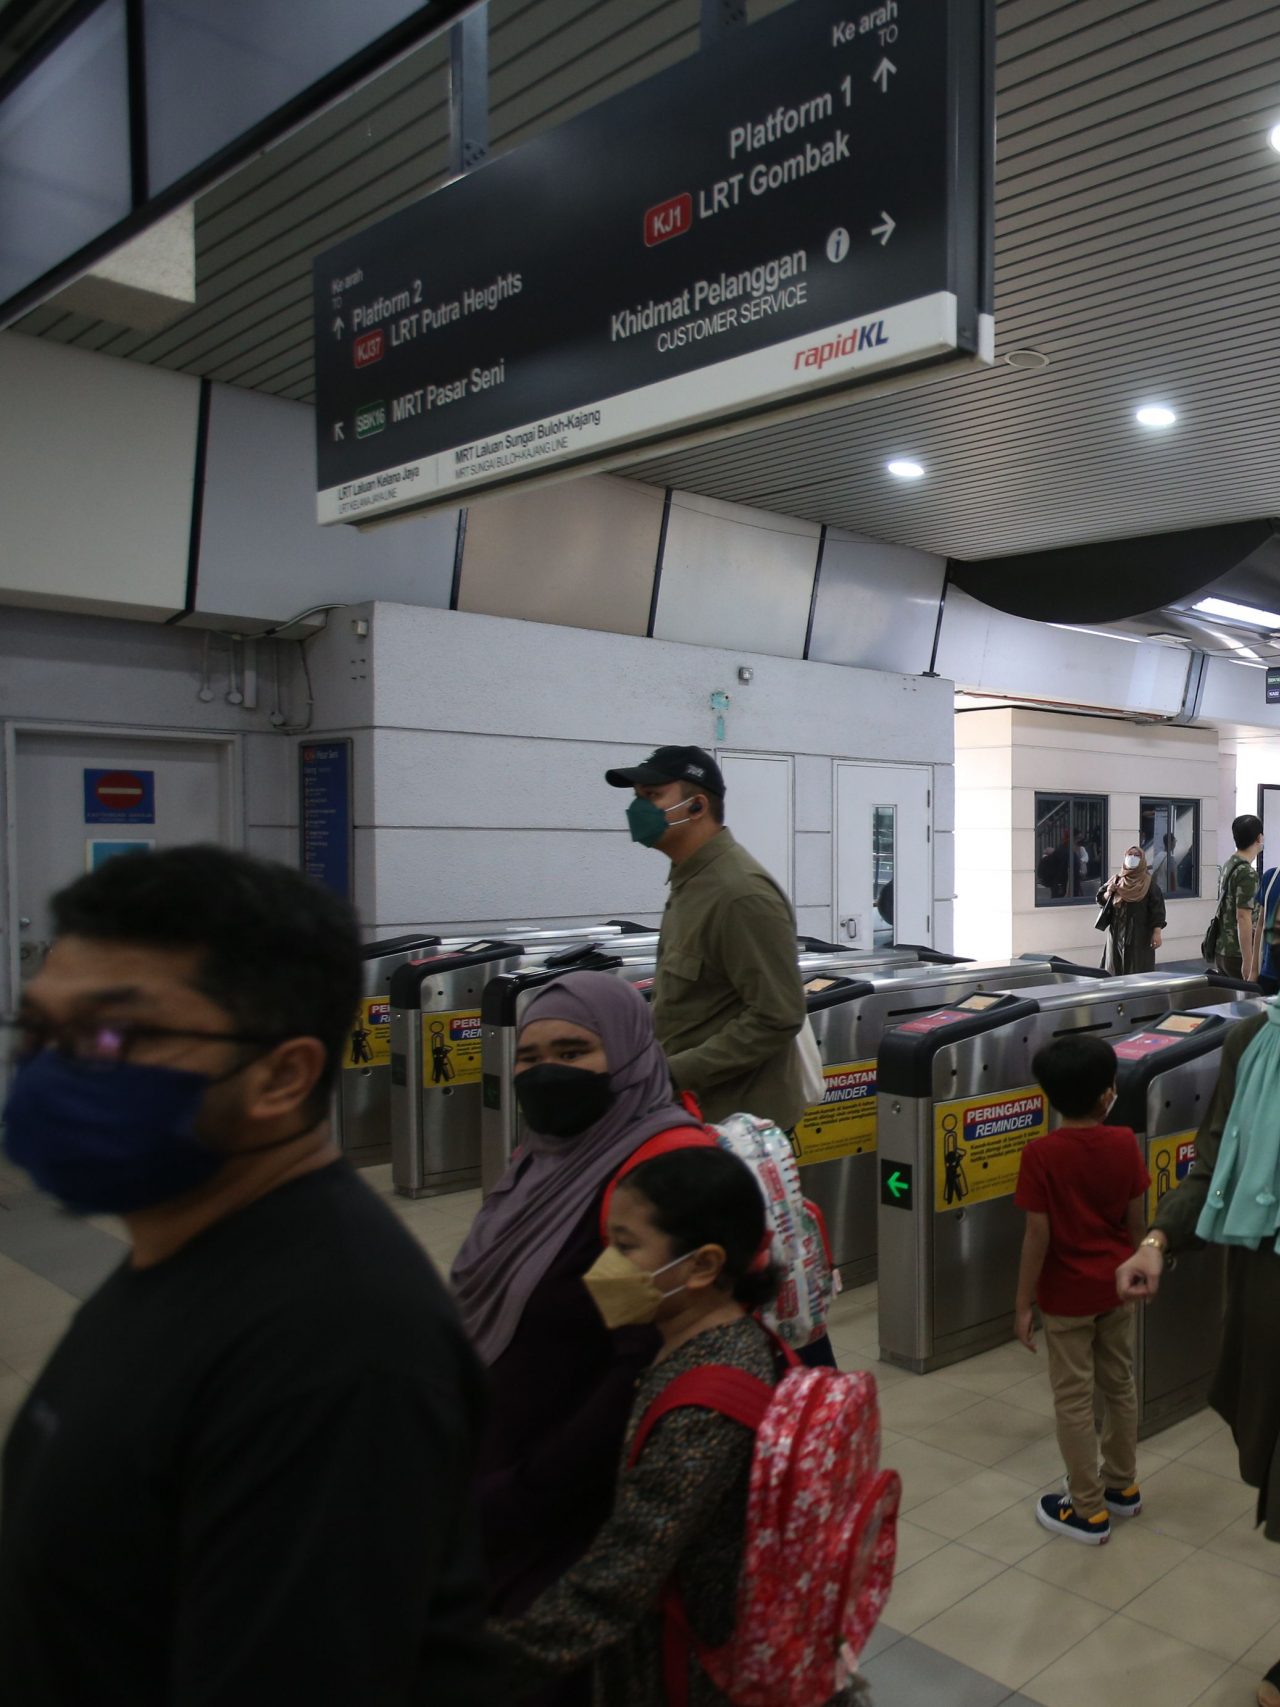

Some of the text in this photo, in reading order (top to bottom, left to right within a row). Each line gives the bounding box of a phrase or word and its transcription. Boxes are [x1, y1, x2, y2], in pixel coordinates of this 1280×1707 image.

[832, 0, 898, 48] Ke arah
[879, 24, 898, 47] TO
[730, 75, 852, 159] Platform 1
[653, 130, 851, 237] KJ1 LRT Gombak
[344, 269, 364, 289] arah
[611, 250, 807, 341] Khidmat Pelanggan
[353, 280, 422, 331] Platform 2
[357, 273, 522, 360] KJ37 LRT Putra Heights
[657, 283, 808, 352] CUSTOMER SERVICE
[793, 320, 889, 370] rapidKL
[392, 358, 505, 422] MRT Pasar Seni
[455, 409, 601, 464] MRT Laluan Sungai Buloh-Kajang
[338, 475, 377, 500] LRT Laluan
[967, 1098, 1041, 1123] PERINGATAN
[975, 1114, 1032, 1138] REMINDER
